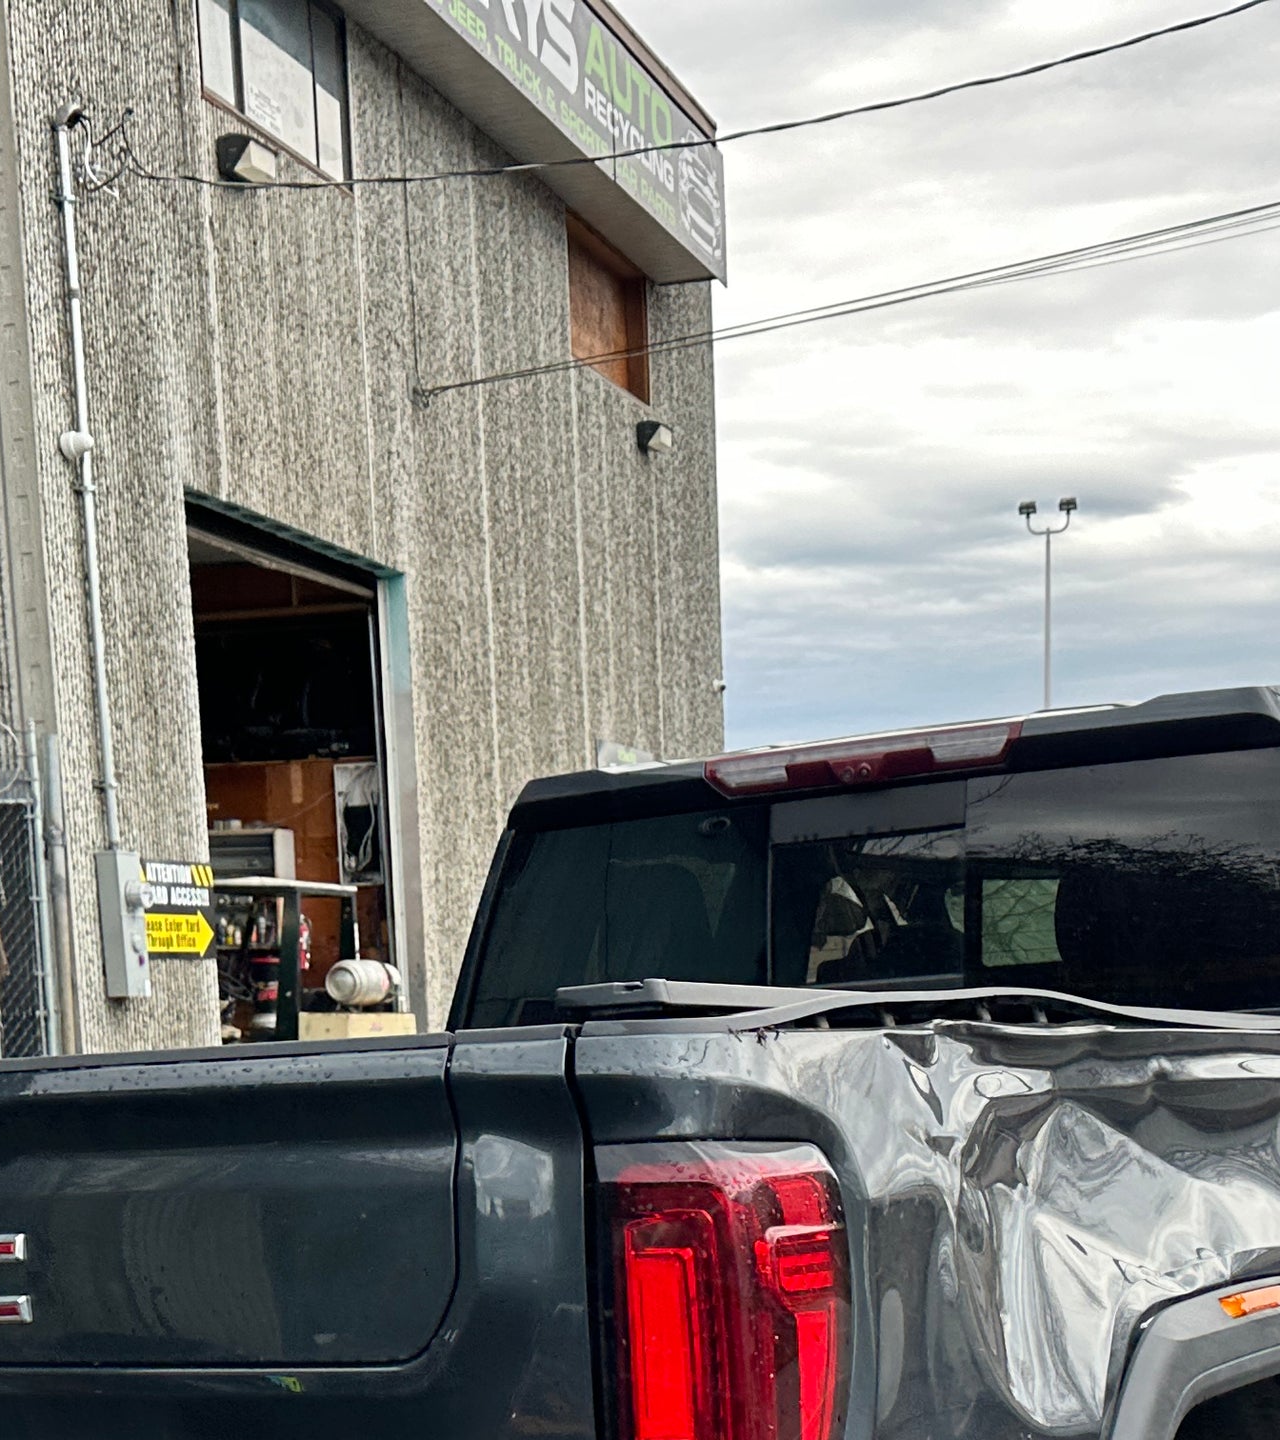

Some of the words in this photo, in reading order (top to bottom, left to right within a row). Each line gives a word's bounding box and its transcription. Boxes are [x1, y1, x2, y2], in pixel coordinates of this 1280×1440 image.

[585, 22, 673, 155] AUTO
[494, 34, 543, 100] TRUCK
[546, 86, 557, 113] &
[559, 100, 609, 154] SPORTS
[640, 180, 676, 226] PARTS
[584, 77, 675, 193] RECYCLING
[145, 862, 193, 884] ATTENTION
[145, 920, 163, 932] ease
[164, 918, 183, 932] Enter
[185, 918, 201, 933] Yard
[146, 933, 174, 949] Through
[175, 934, 197, 948] Office
